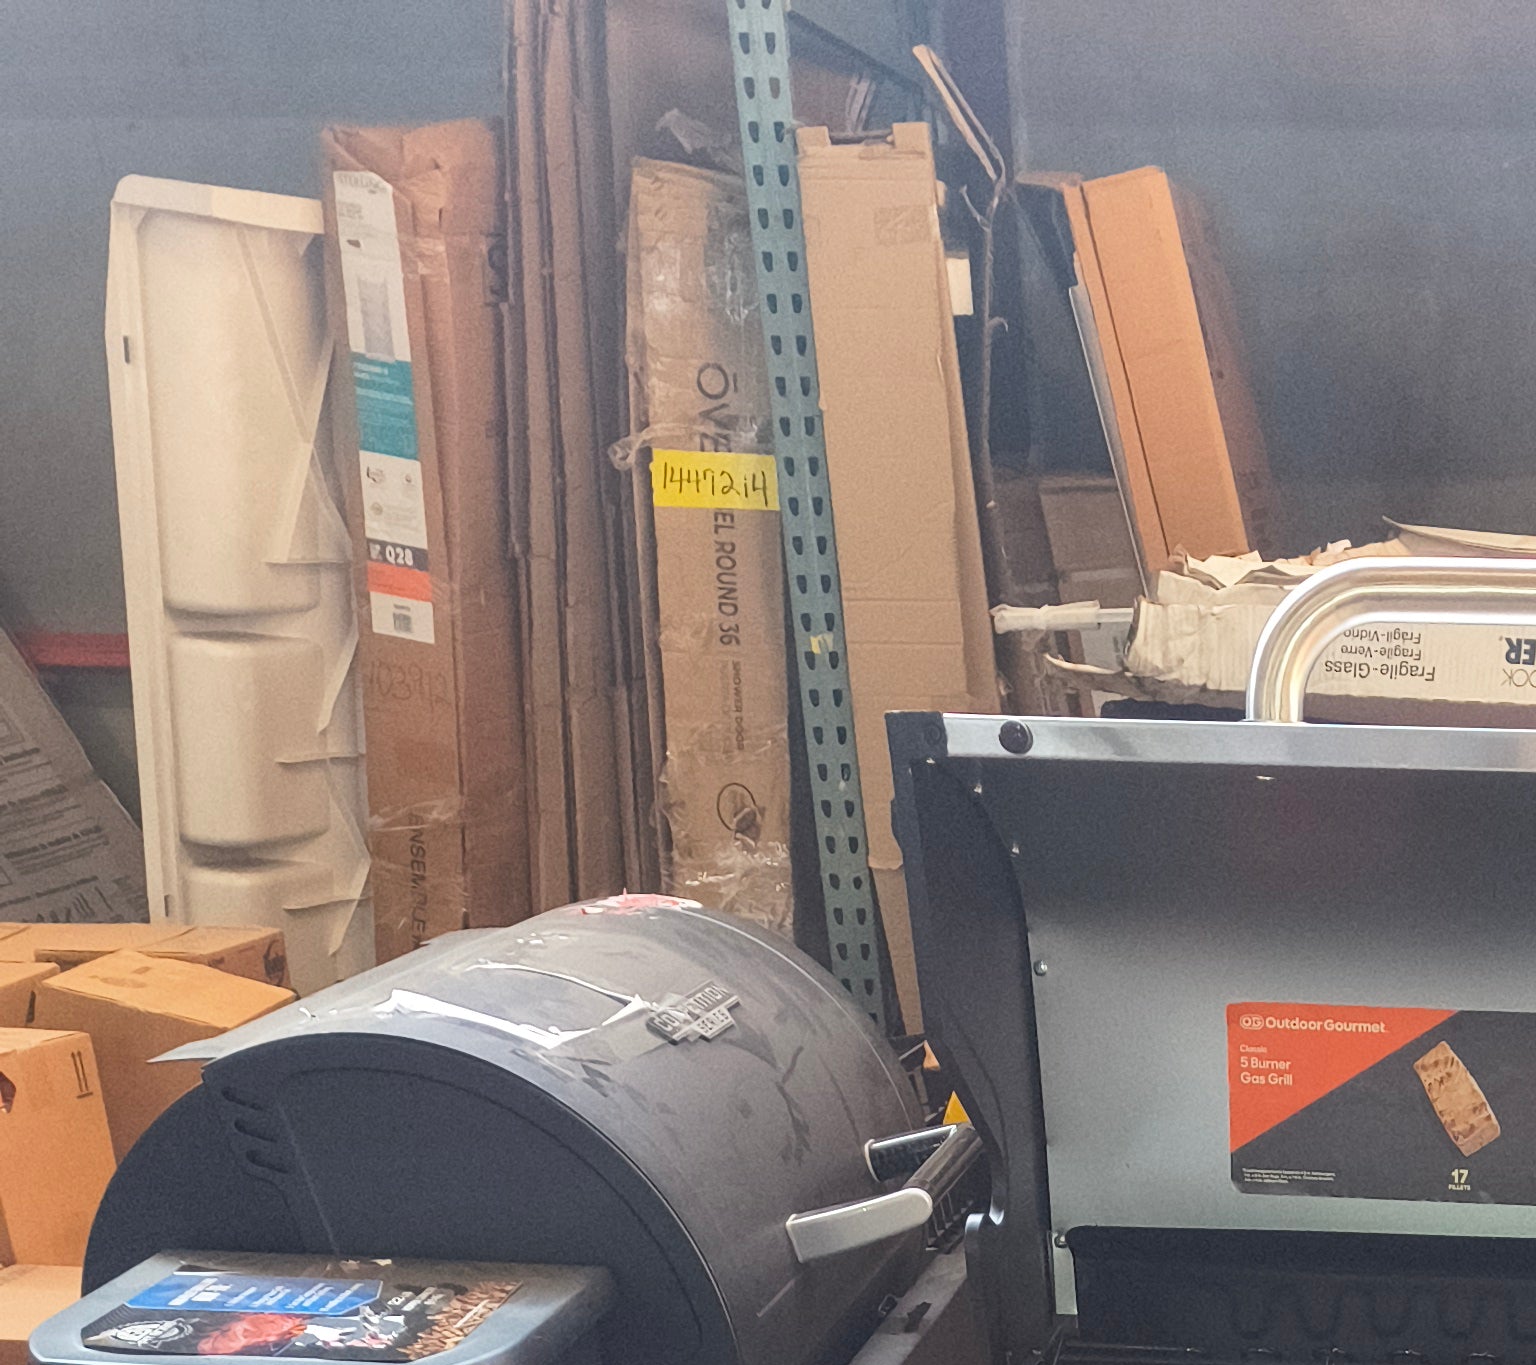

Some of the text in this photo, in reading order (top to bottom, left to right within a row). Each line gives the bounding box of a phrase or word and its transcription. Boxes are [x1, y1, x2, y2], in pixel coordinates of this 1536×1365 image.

[385, 545, 414, 567] Q28
[715, 541, 738, 617] ROUND
[720, 623, 741, 647] 36
[1324, 660, 1436, 682] Fragile-Glass
[1265, 1017, 1323, 1031] Outdoor
[1324, 1019, 1386, 1033] Gourmet
[1240, 1056, 1291, 1070] 5 Burner
[1240, 1072, 1293, 1086] Gas Grill
[1451, 1169, 1468, 1184] 17
